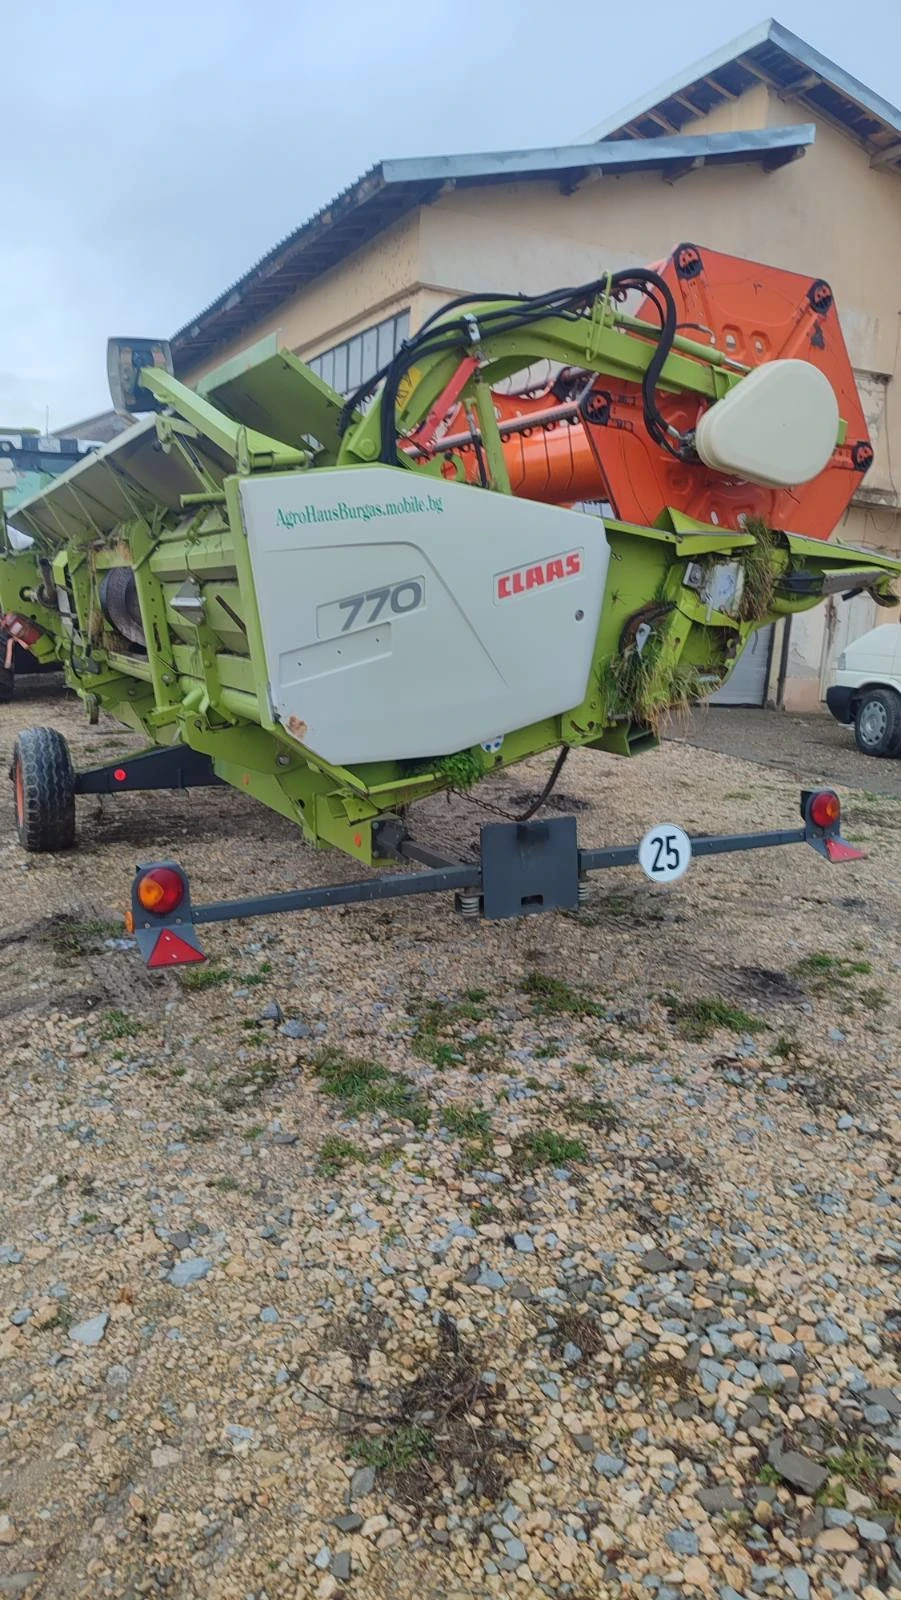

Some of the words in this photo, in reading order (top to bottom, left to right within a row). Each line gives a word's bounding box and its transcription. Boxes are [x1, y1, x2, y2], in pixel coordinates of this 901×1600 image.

[497, 552, 581, 600] CLAAS
[339, 581, 422, 632] 770
[651, 835, 680, 873] 25
